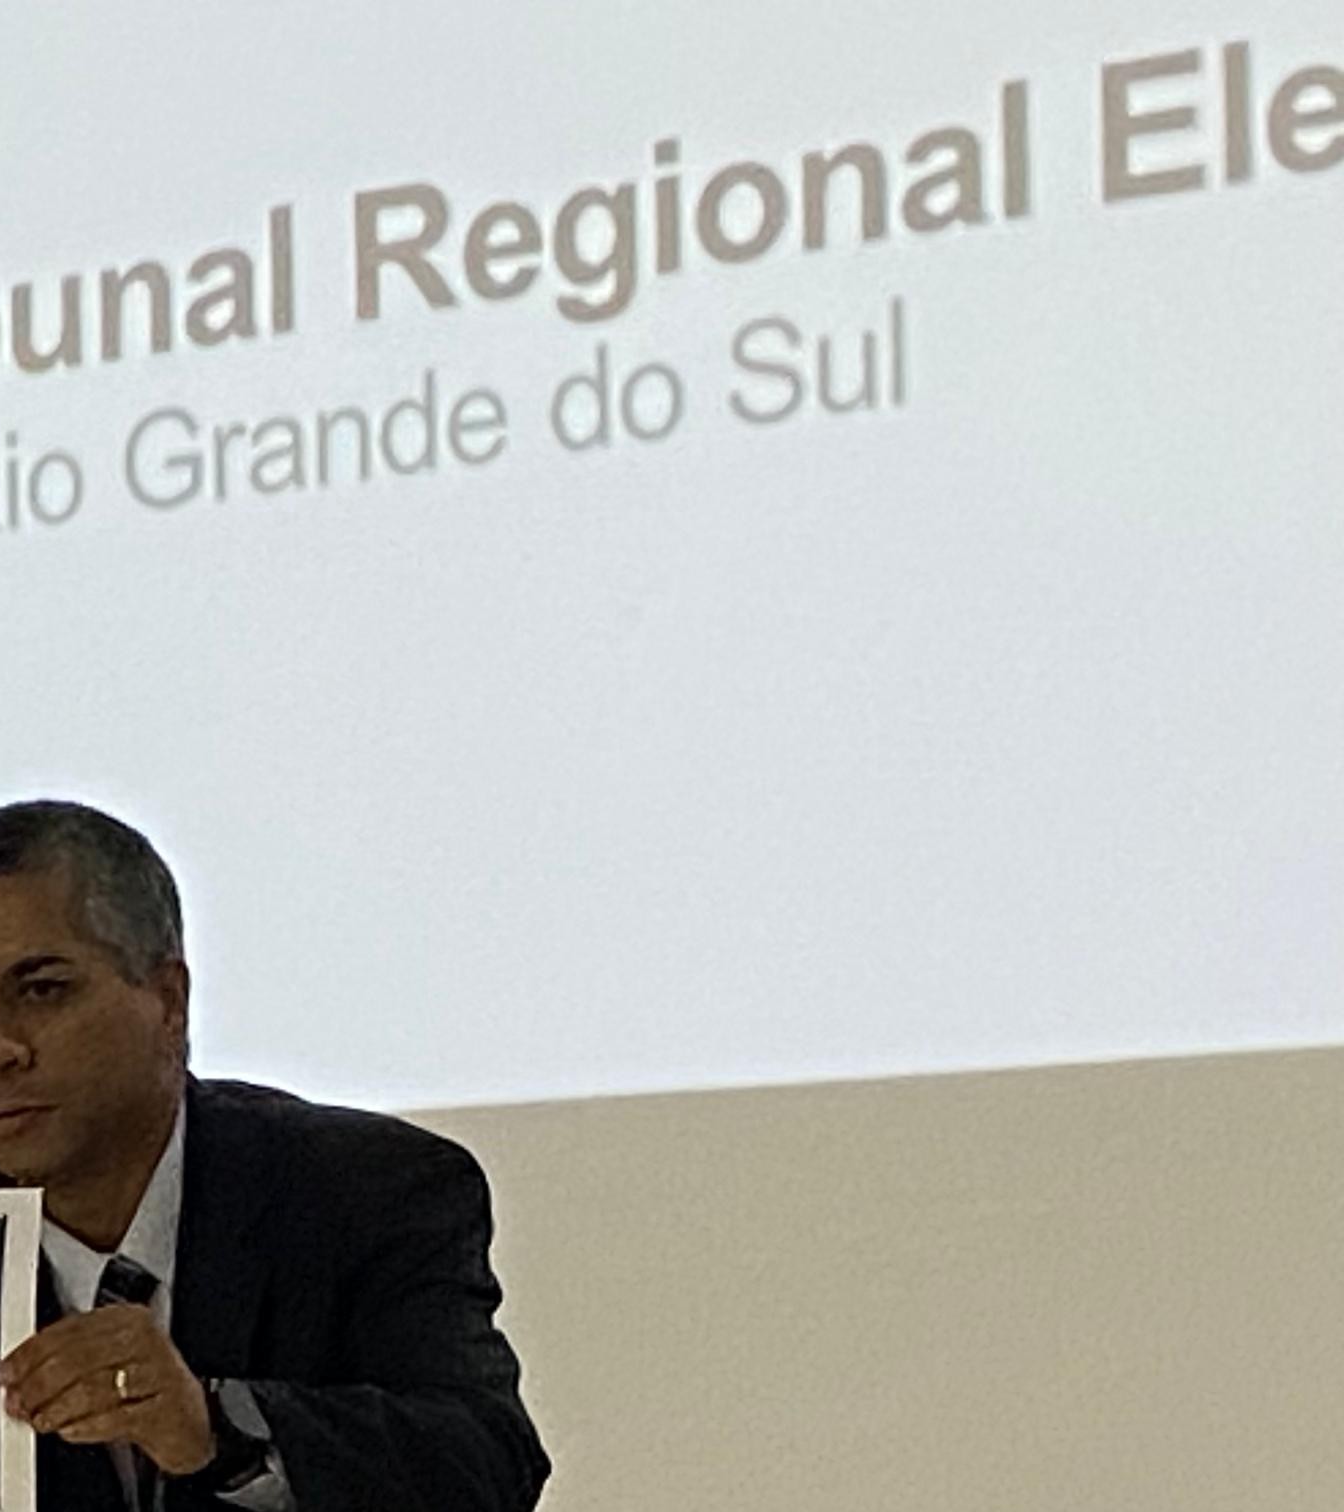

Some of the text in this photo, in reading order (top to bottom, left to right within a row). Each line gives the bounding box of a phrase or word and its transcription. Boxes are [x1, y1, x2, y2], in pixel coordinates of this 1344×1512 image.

[353, 77, 1034, 327] Regional
[1099, 39, 1344, 208] Ele
[122, 365, 510, 513] Grande
[546, 339, 687, 454] do
[726, 294, 907, 427] Sul
